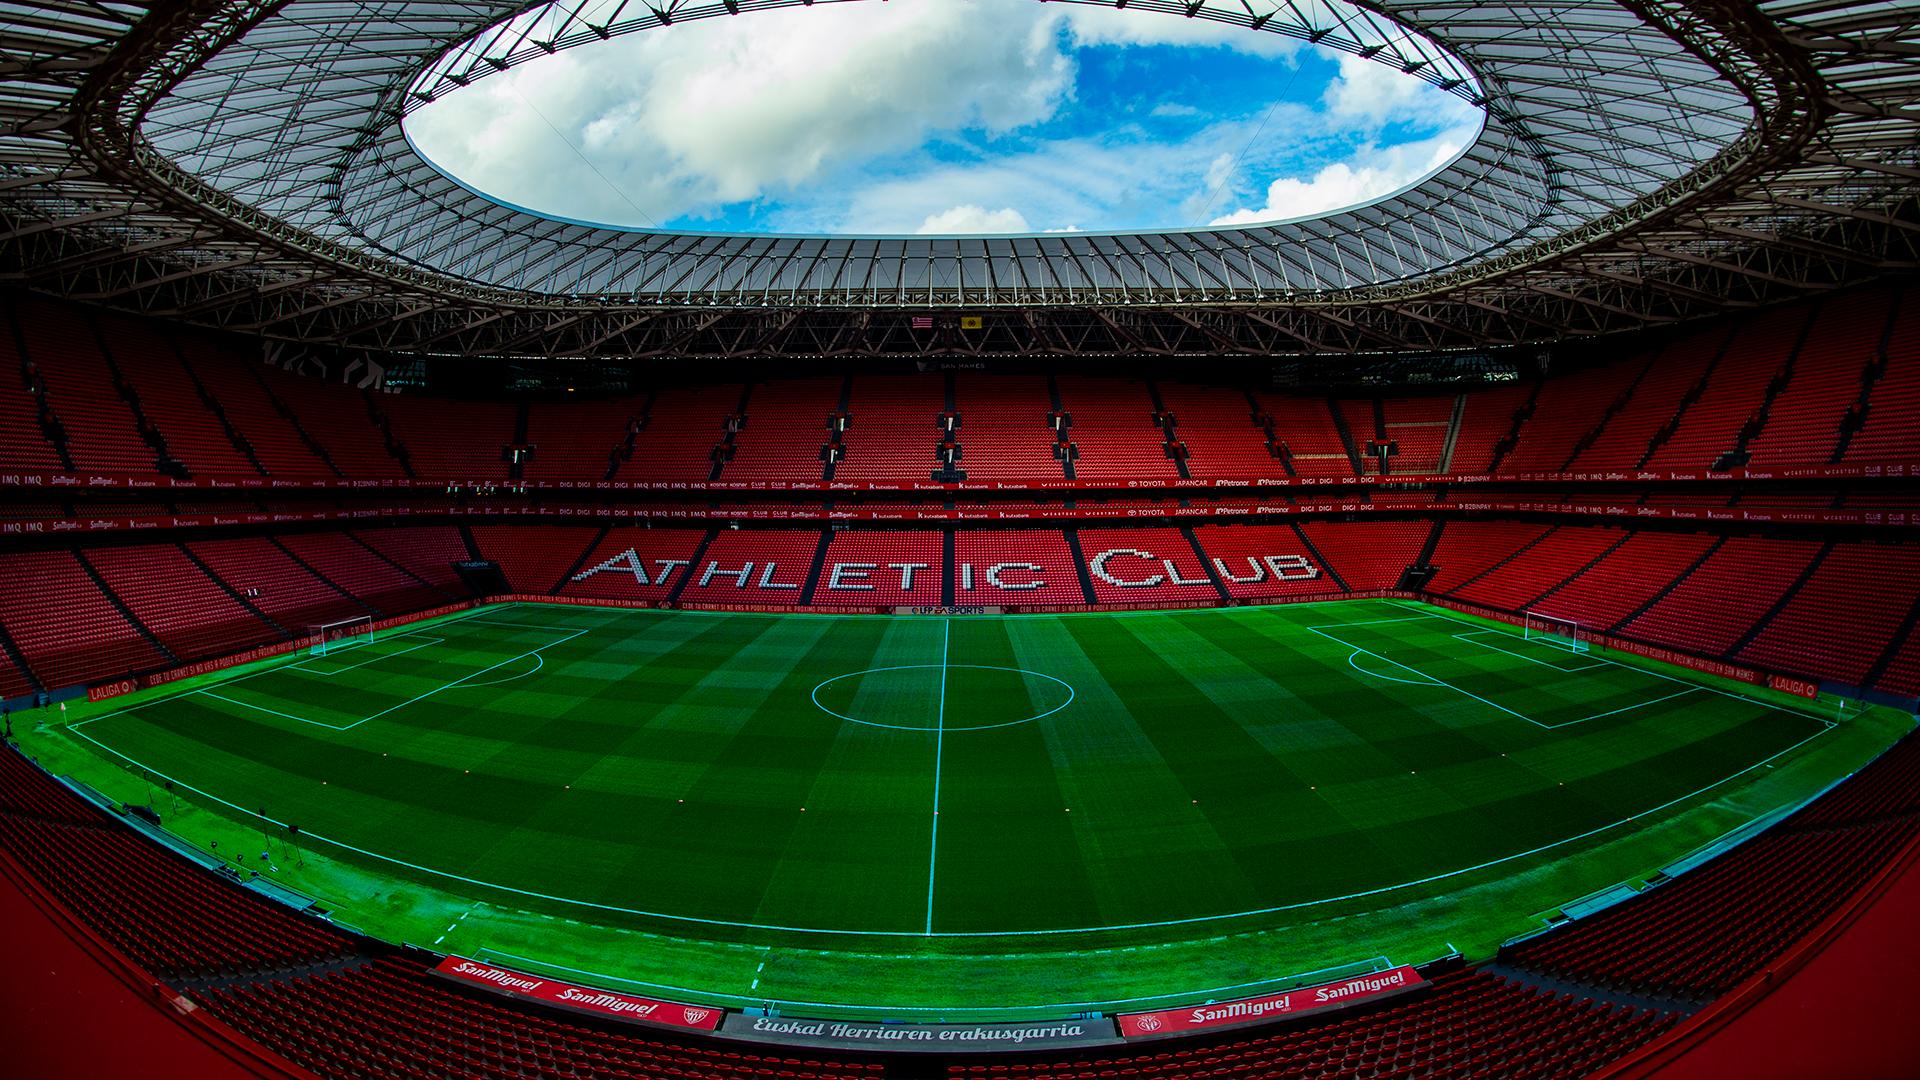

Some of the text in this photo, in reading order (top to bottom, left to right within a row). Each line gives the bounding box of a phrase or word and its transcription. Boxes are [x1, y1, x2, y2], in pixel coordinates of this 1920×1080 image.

[2, 475, 20, 486] IMQ
[24, 475, 42, 486] IMQ
[3, 523, 22, 533] IMQ
[26, 522, 44, 532] IMQ
[948, 606, 984, 614] SPORTS
[1593, 633, 1607, 644] CARN
[90, 684, 120, 700] LALIGA
[1776, 676, 1804, 694] LALIGA
[452, 962, 543, 990] SanMiguel
[1315, 971, 1404, 1002] SanMiguel
[556, 988, 659, 1014] SanMiguel
[1188, 995, 1290, 1023] SanMiguel
[753, 1018, 1085, 1042] Euskal Herriaren erakusgarria
